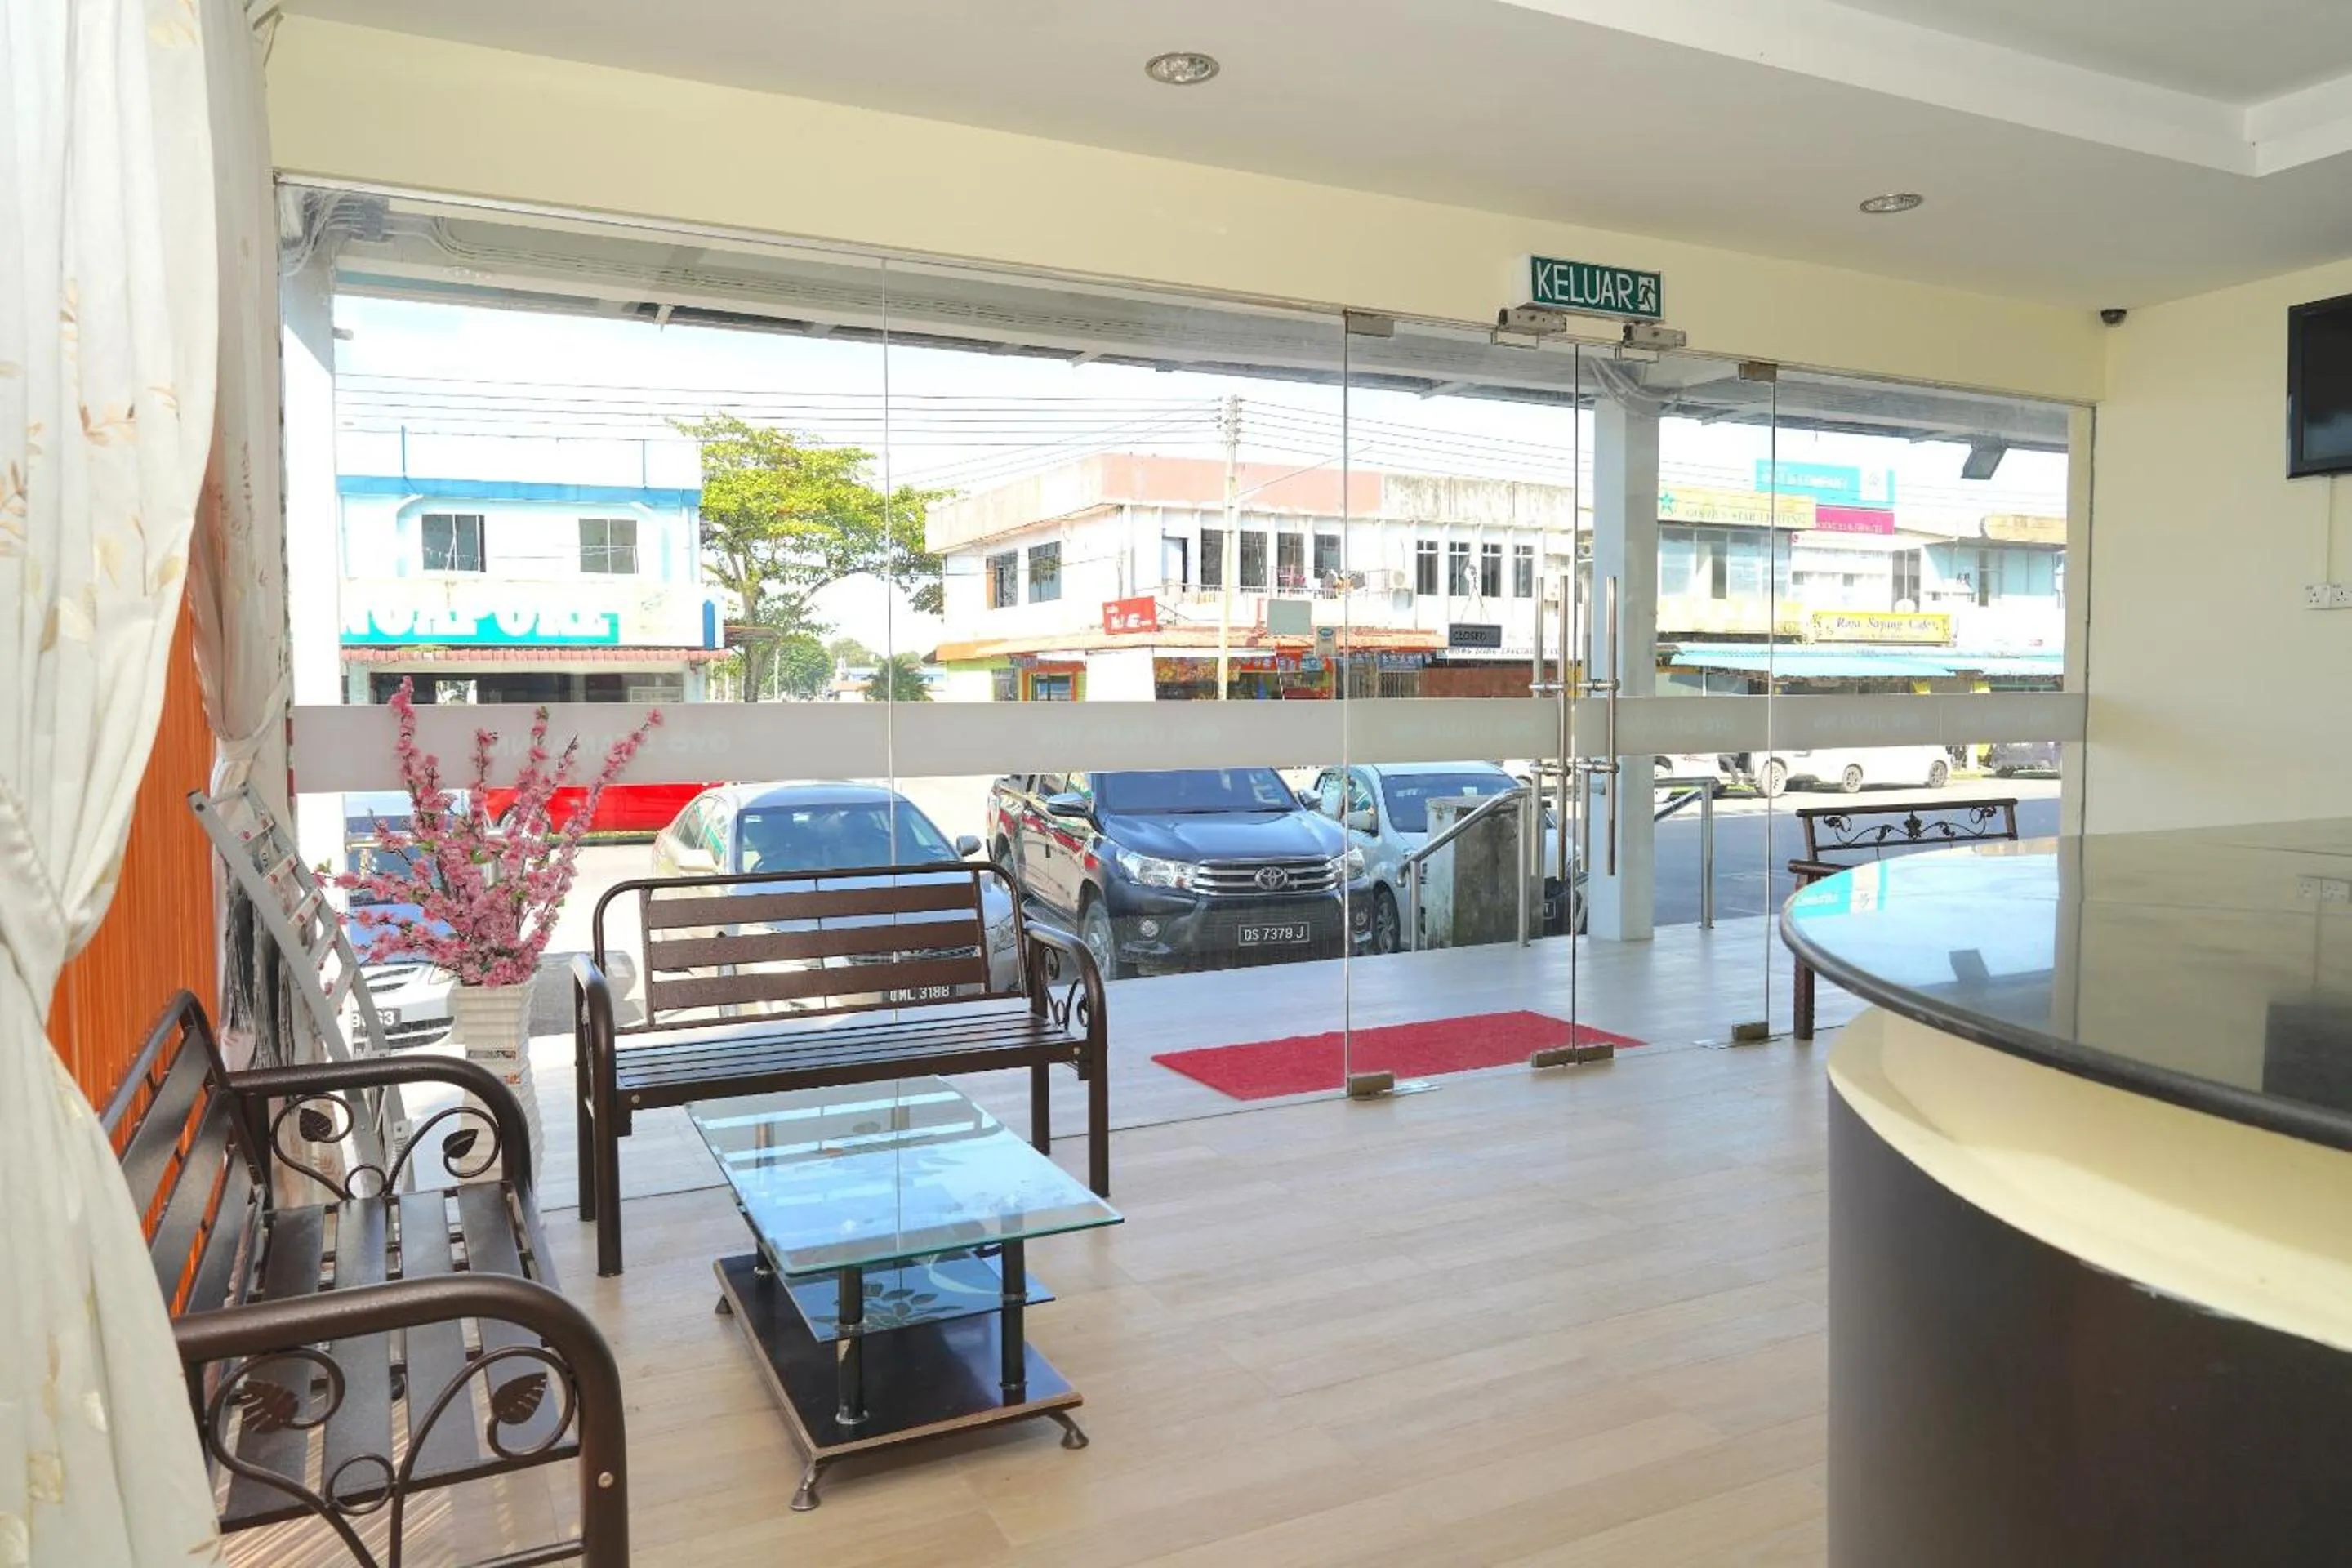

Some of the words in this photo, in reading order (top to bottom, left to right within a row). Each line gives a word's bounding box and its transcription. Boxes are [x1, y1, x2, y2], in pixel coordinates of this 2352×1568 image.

[1535, 261, 1633, 310] KELUAR
[1454, 630, 1489, 641] CLOSED
[1296, 925, 1304, 939] J
